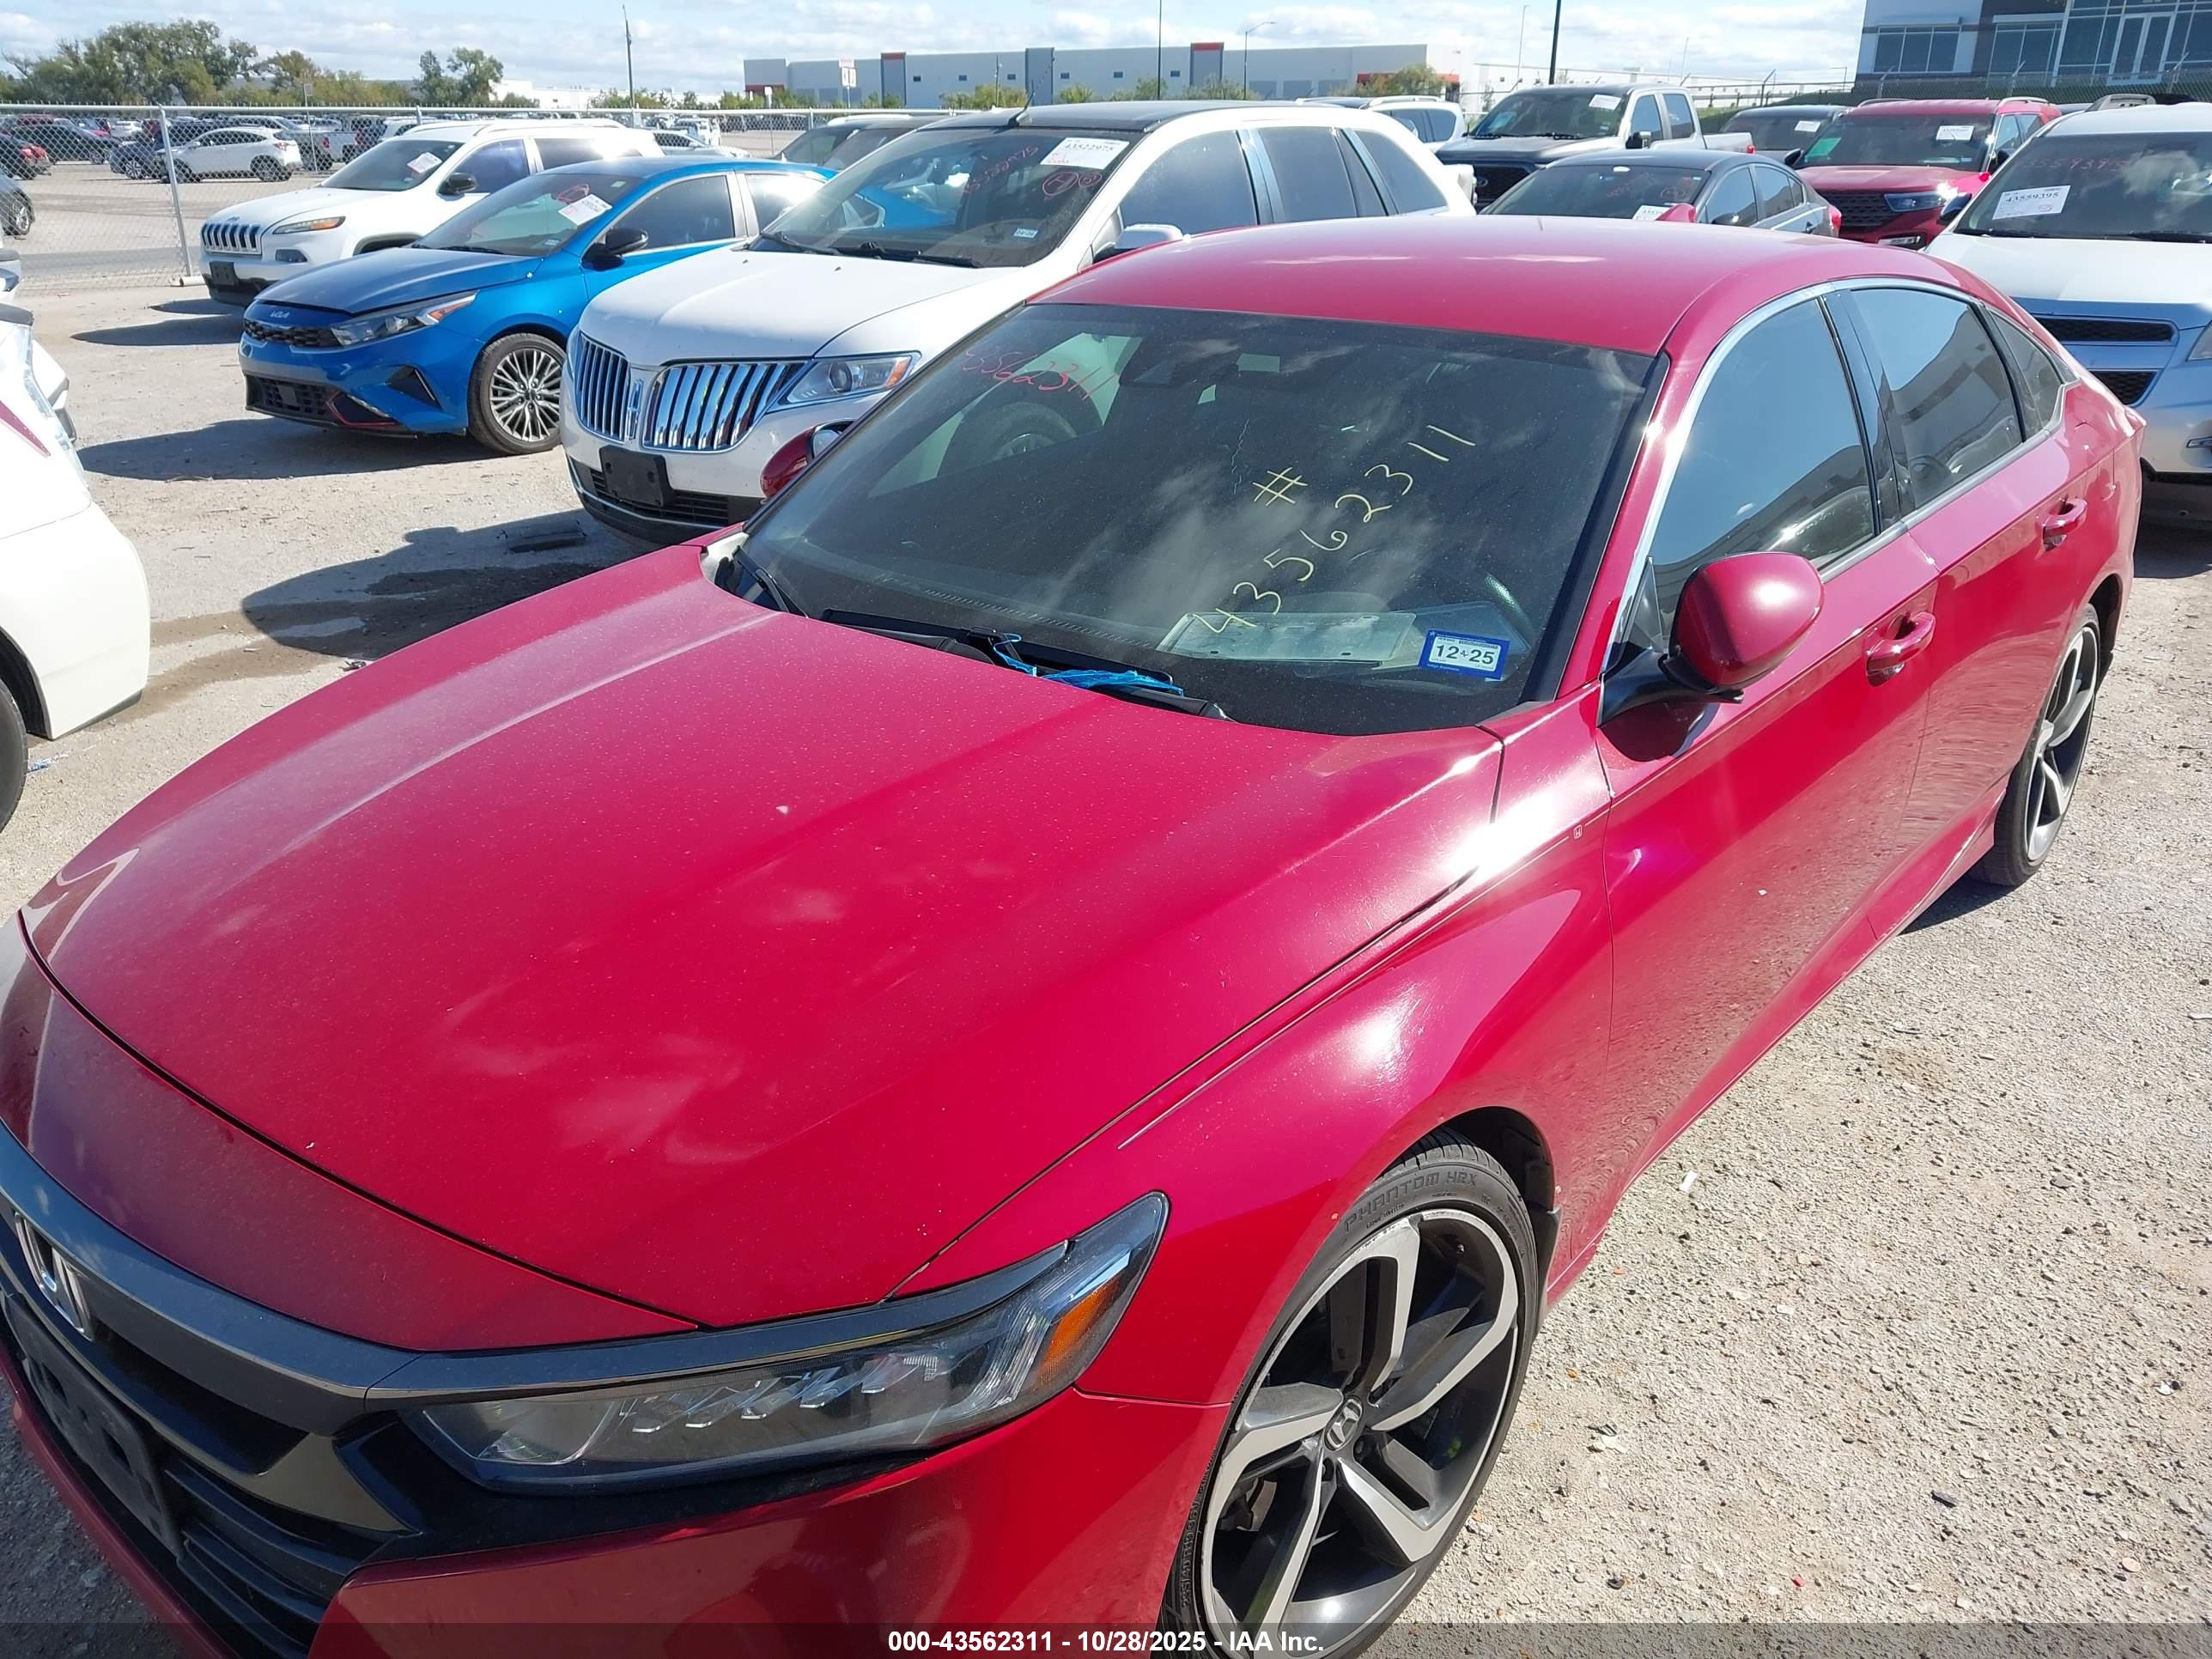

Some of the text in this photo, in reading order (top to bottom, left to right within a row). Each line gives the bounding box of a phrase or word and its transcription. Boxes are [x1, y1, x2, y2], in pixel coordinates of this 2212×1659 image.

[2005, 191, 2060, 203] 43559395
[1192, 424, 1476, 634] 43562311
[1344, 1171, 1441, 1232] PHANTOM
[1446, 1170, 1477, 1188] HRX
